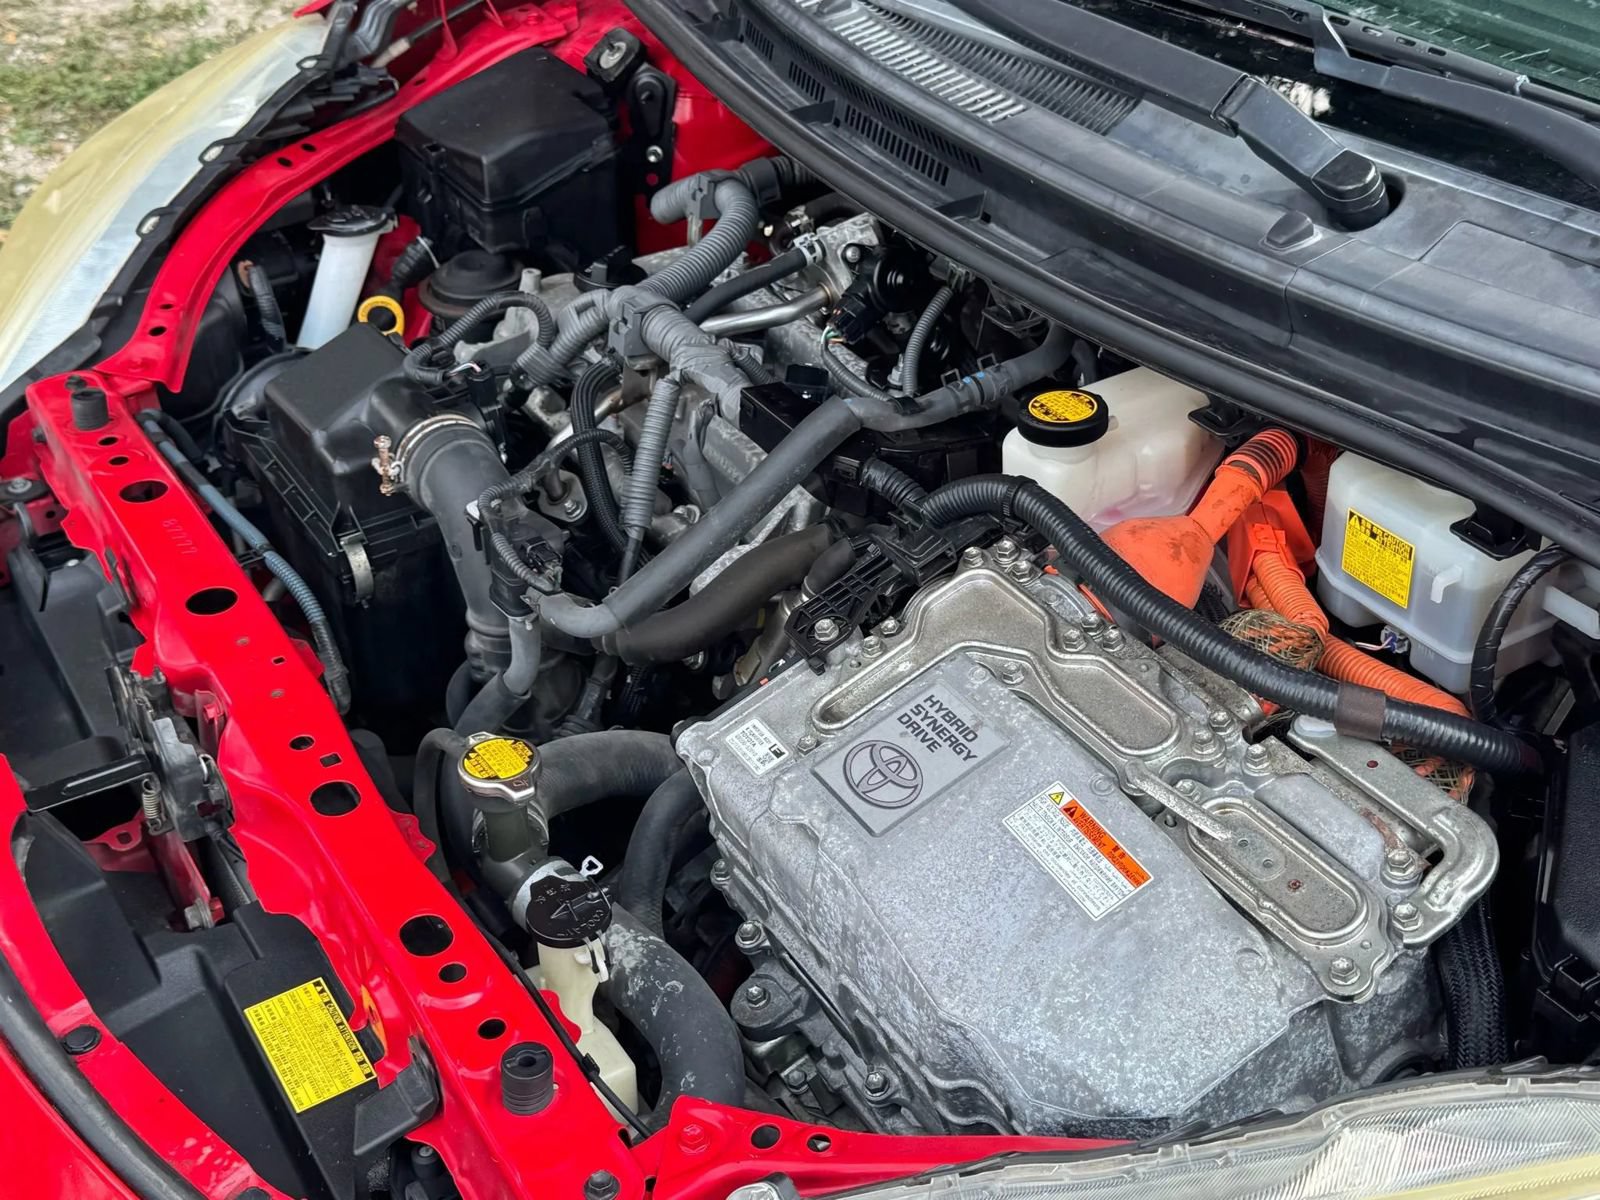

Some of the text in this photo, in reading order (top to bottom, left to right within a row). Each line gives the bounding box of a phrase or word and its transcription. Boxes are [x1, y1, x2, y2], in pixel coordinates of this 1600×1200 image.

[896, 712, 942, 753] DRIVE
[909, 703, 978, 761] SYNERGY
[923, 694, 978, 742] HYBRID
[1078, 811, 1106, 838] WARNING
[325, 1002, 357, 1051] CAUTION ATTENTION
